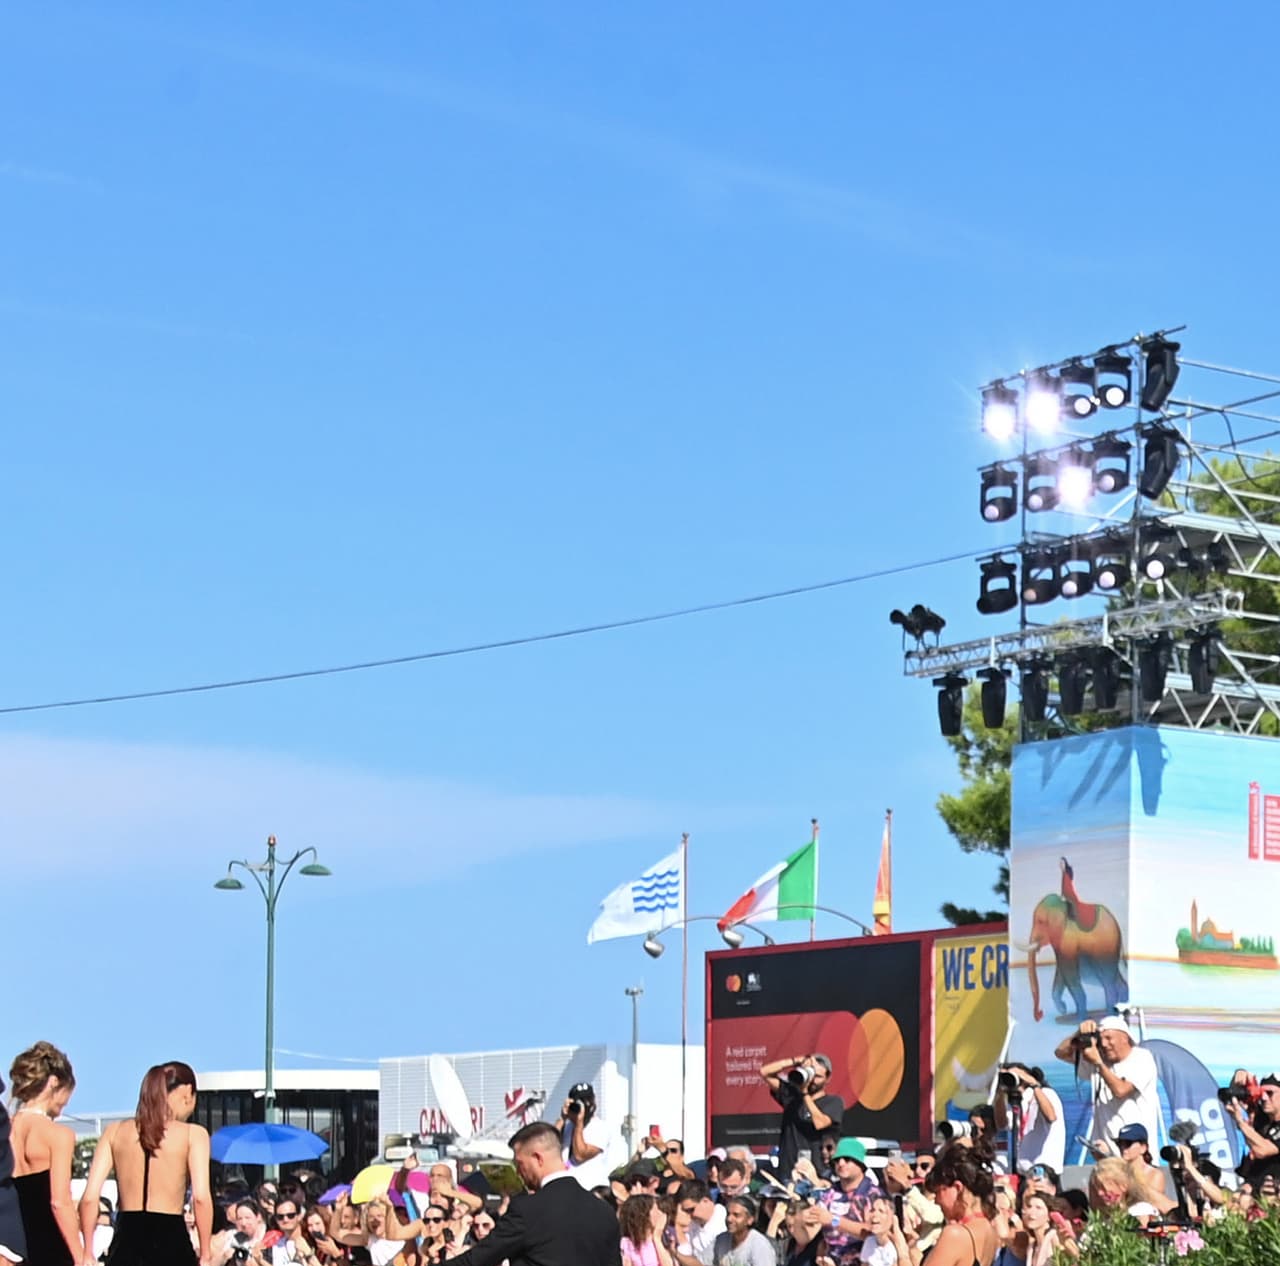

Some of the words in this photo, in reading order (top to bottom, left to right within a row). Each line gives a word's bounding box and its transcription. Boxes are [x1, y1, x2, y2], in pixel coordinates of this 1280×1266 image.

[942, 946, 976, 992] WE
[725, 1046, 732, 1057] A
[732, 1046, 744, 1057] red
[745, 1045, 768, 1058] carpet
[420, 1107, 484, 1137] CAMRI
